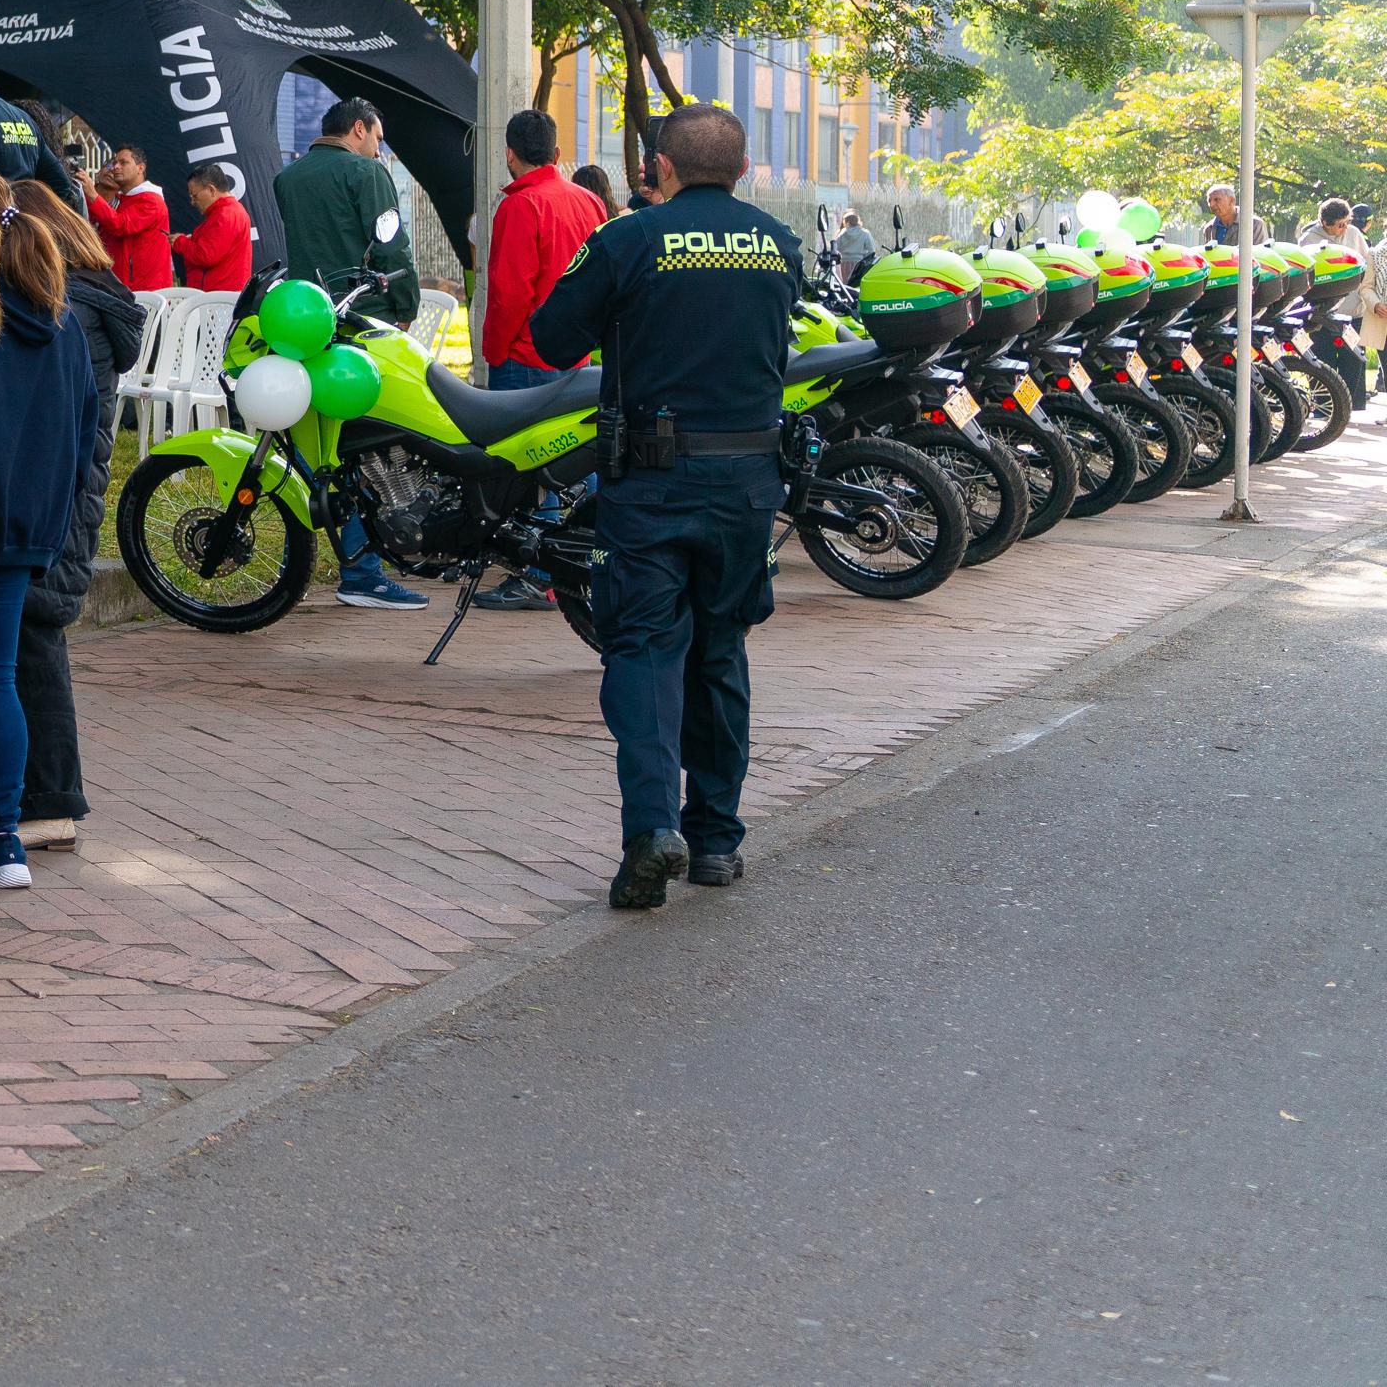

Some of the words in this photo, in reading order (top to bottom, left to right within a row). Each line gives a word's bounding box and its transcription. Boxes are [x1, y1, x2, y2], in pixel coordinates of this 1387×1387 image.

[0, 118, 34, 136] POLICÍA
[663, 226, 780, 256] POLICÍA
[871, 300, 915, 312] POLICÍA
[525, 431, 580, 463] 17-1-3325
